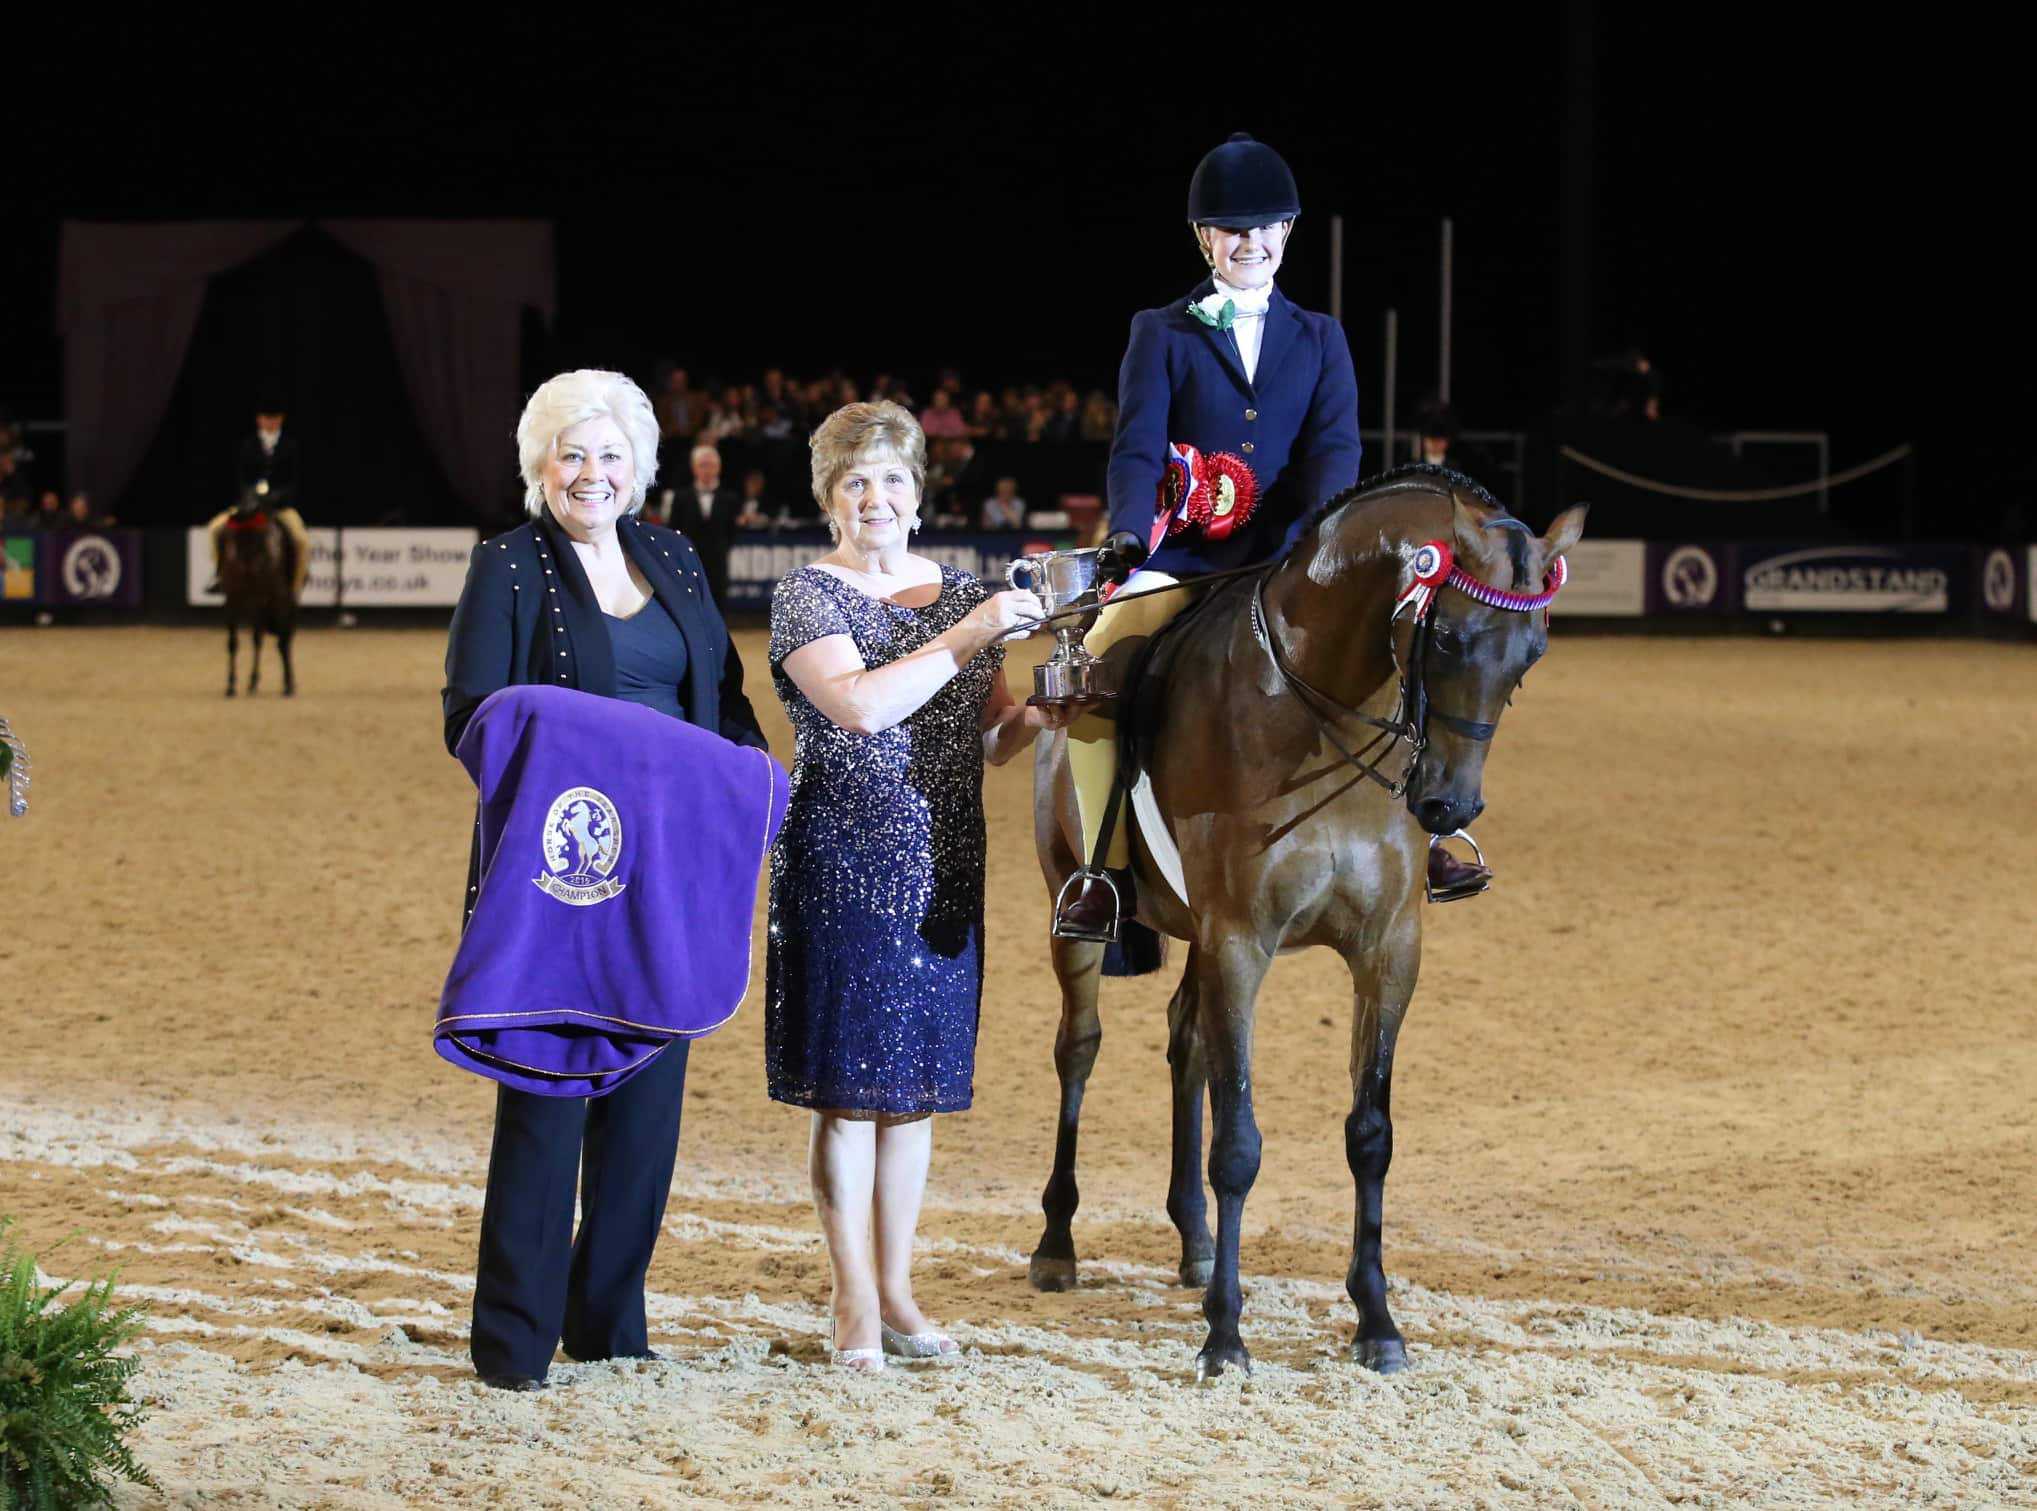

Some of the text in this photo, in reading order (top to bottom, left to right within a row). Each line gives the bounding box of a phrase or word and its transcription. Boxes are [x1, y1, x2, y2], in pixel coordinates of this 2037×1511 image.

[357, 545, 401, 562] Year
[408, 545, 467, 562] Show
[1744, 567, 1947, 594] GRANDSTAND
[552, 883, 608, 900] CHAMPION
